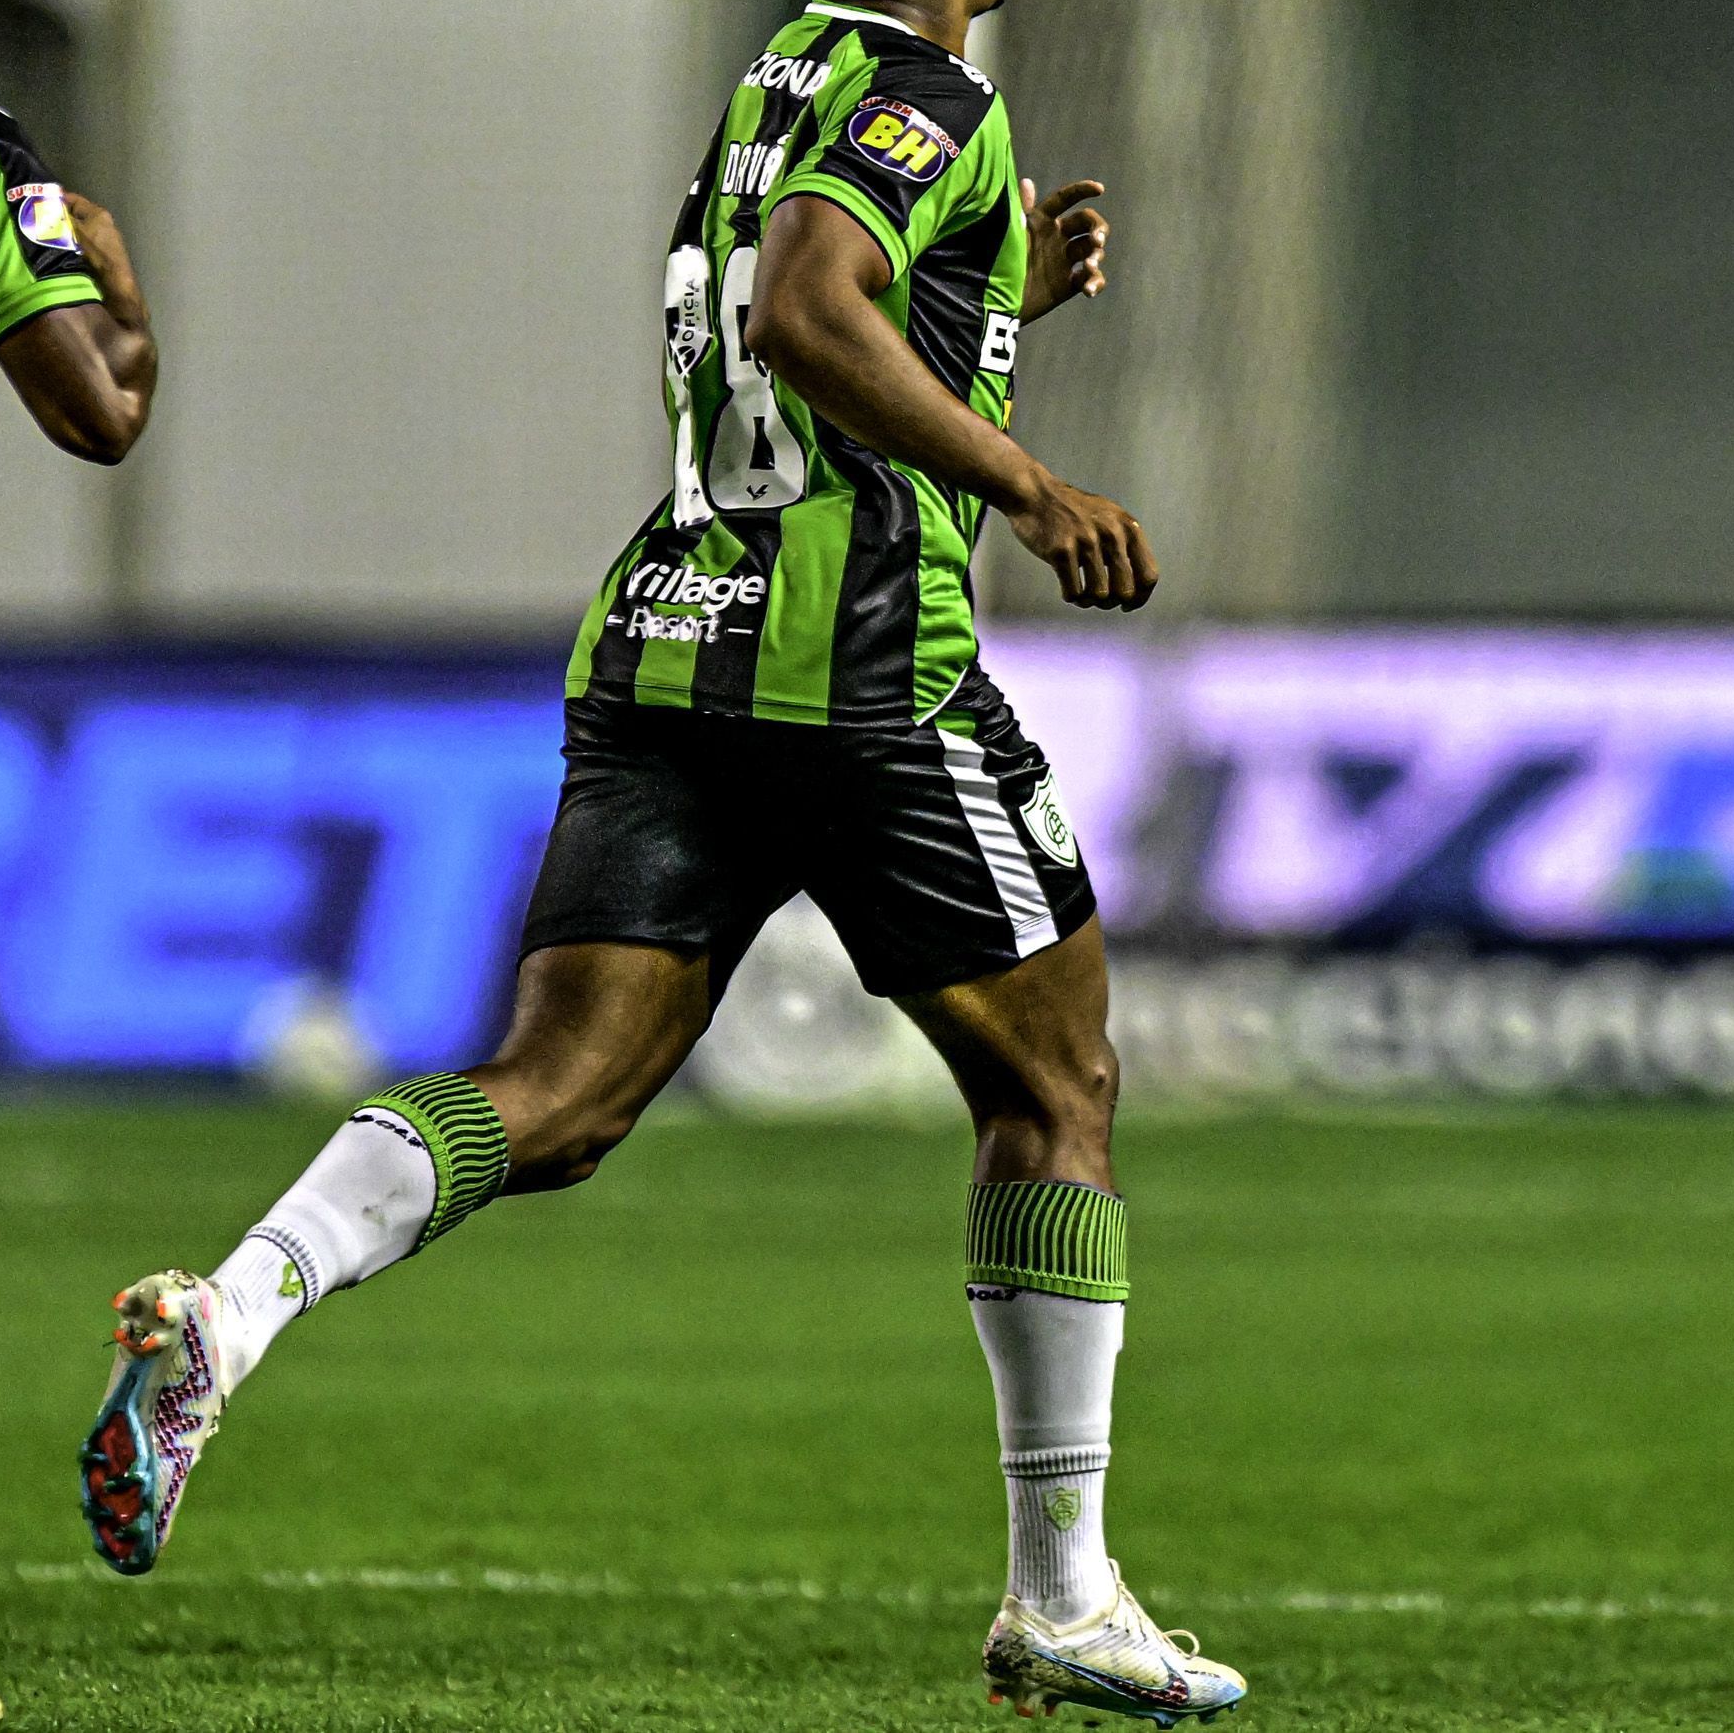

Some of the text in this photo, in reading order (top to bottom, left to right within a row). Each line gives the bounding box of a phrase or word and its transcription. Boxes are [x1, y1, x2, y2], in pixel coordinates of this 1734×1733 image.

[857, 113, 940, 173] BH
[858, 96, 960, 158] SUPERMCADOS
[682, 267, 695, 342] OFICIA
